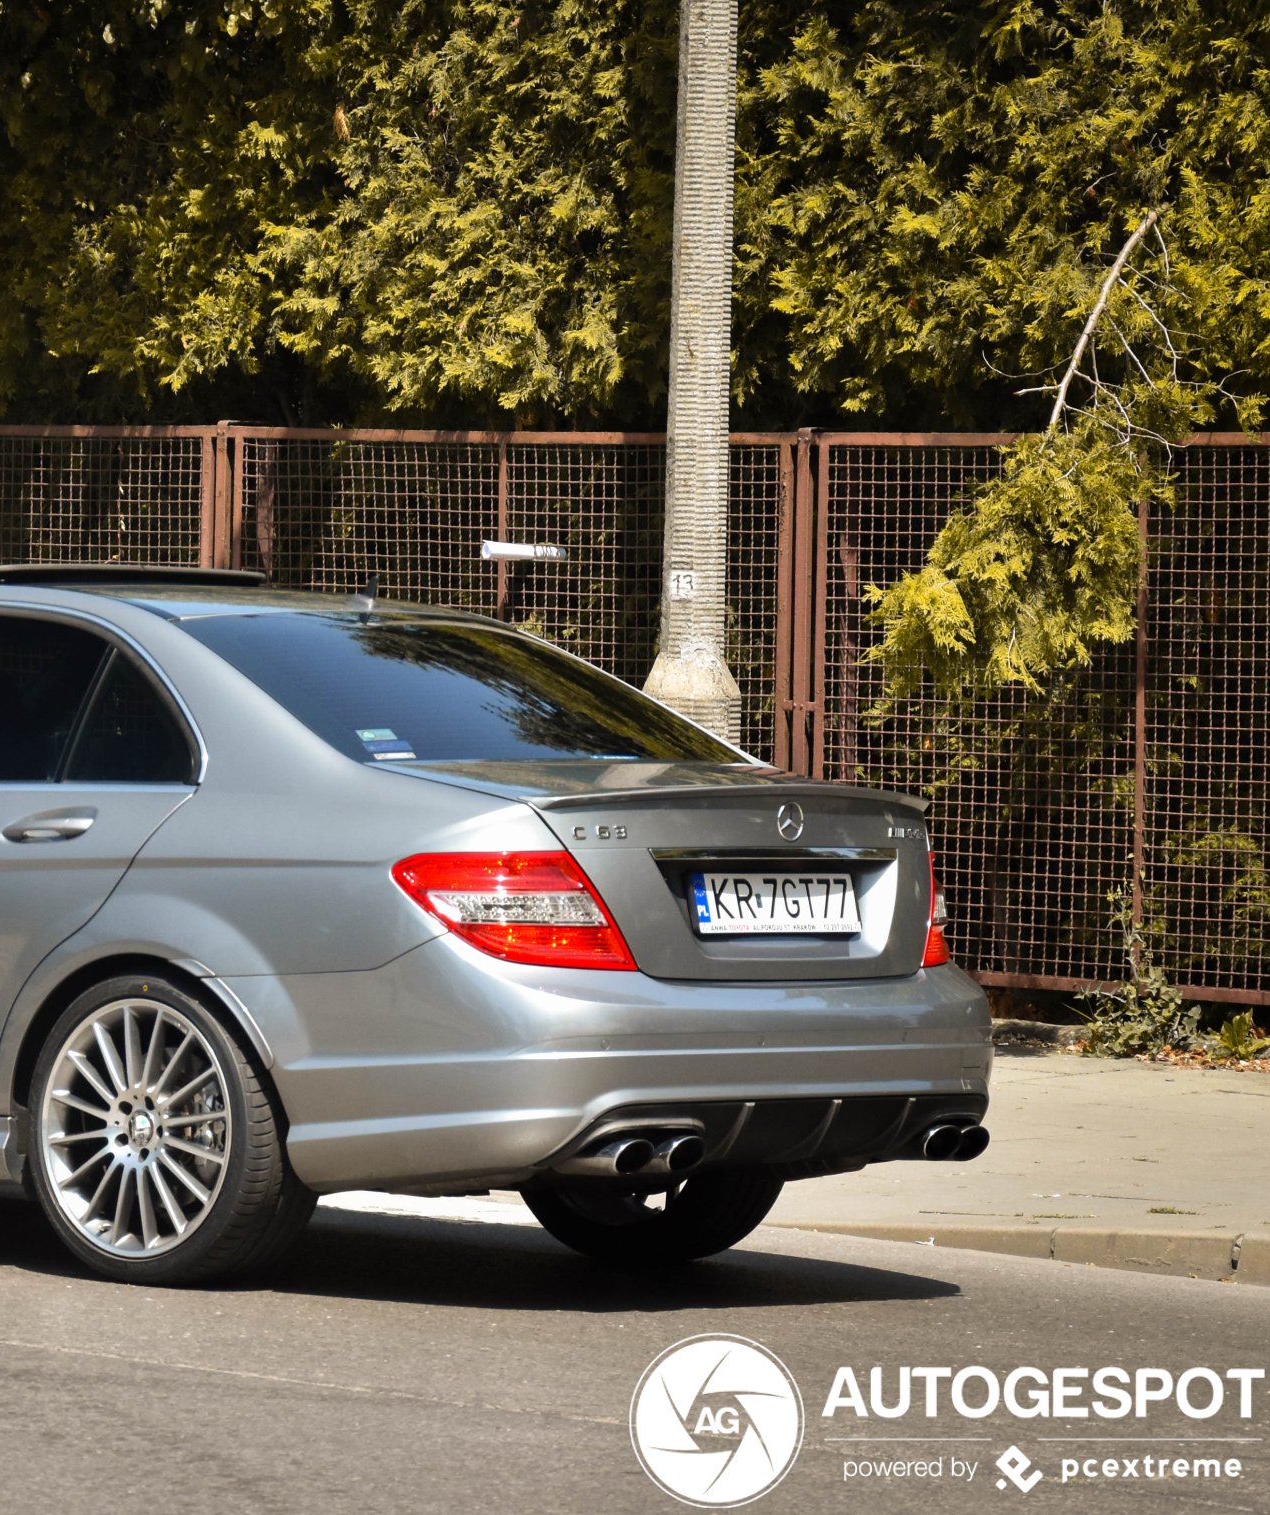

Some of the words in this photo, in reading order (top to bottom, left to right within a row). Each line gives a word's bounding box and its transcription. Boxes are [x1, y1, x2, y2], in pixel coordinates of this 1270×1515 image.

[672, 574, 694, 596] 13
[573, 826, 587, 840] C
[595, 825, 628, 840] 63
[711, 878, 758, 919] KR
[762, 878, 848, 919] 7GT77
[697, 904, 710, 917] PL
